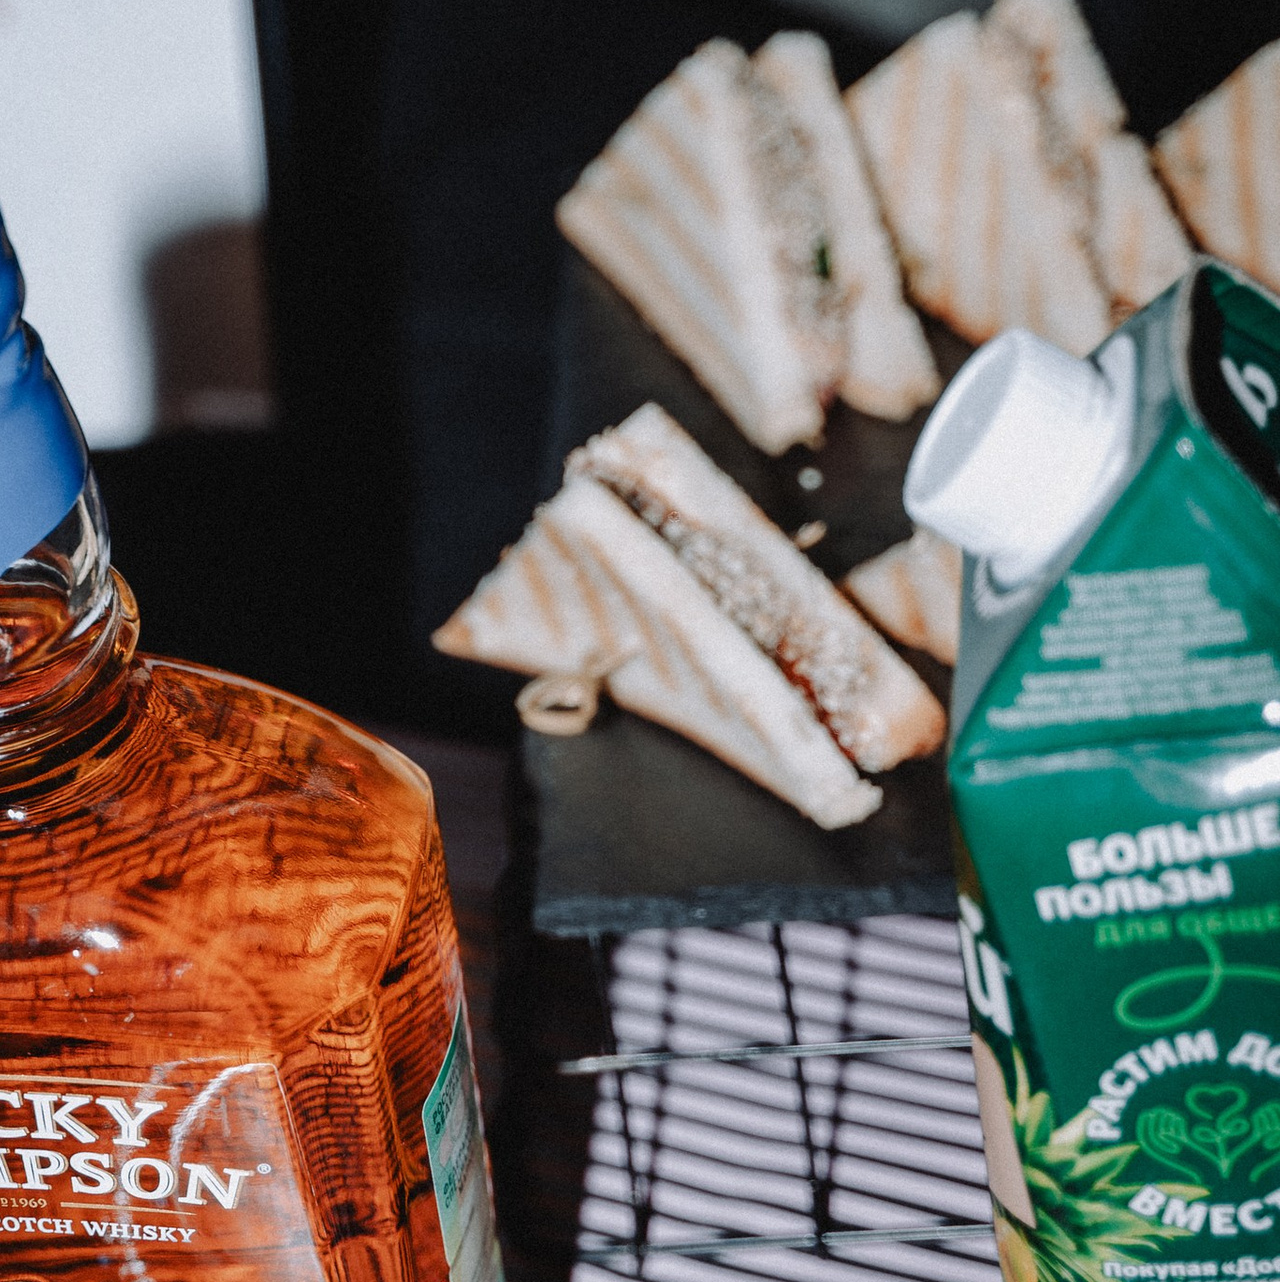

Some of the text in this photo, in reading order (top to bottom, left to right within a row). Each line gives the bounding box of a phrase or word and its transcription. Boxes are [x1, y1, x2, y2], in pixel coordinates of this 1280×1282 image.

[1085, 1029, 1220, 1141] РАСТИМ
[85, 1220, 197, 1244] WHISKY
[1102, 1260, 1218, 1281] Покупая
